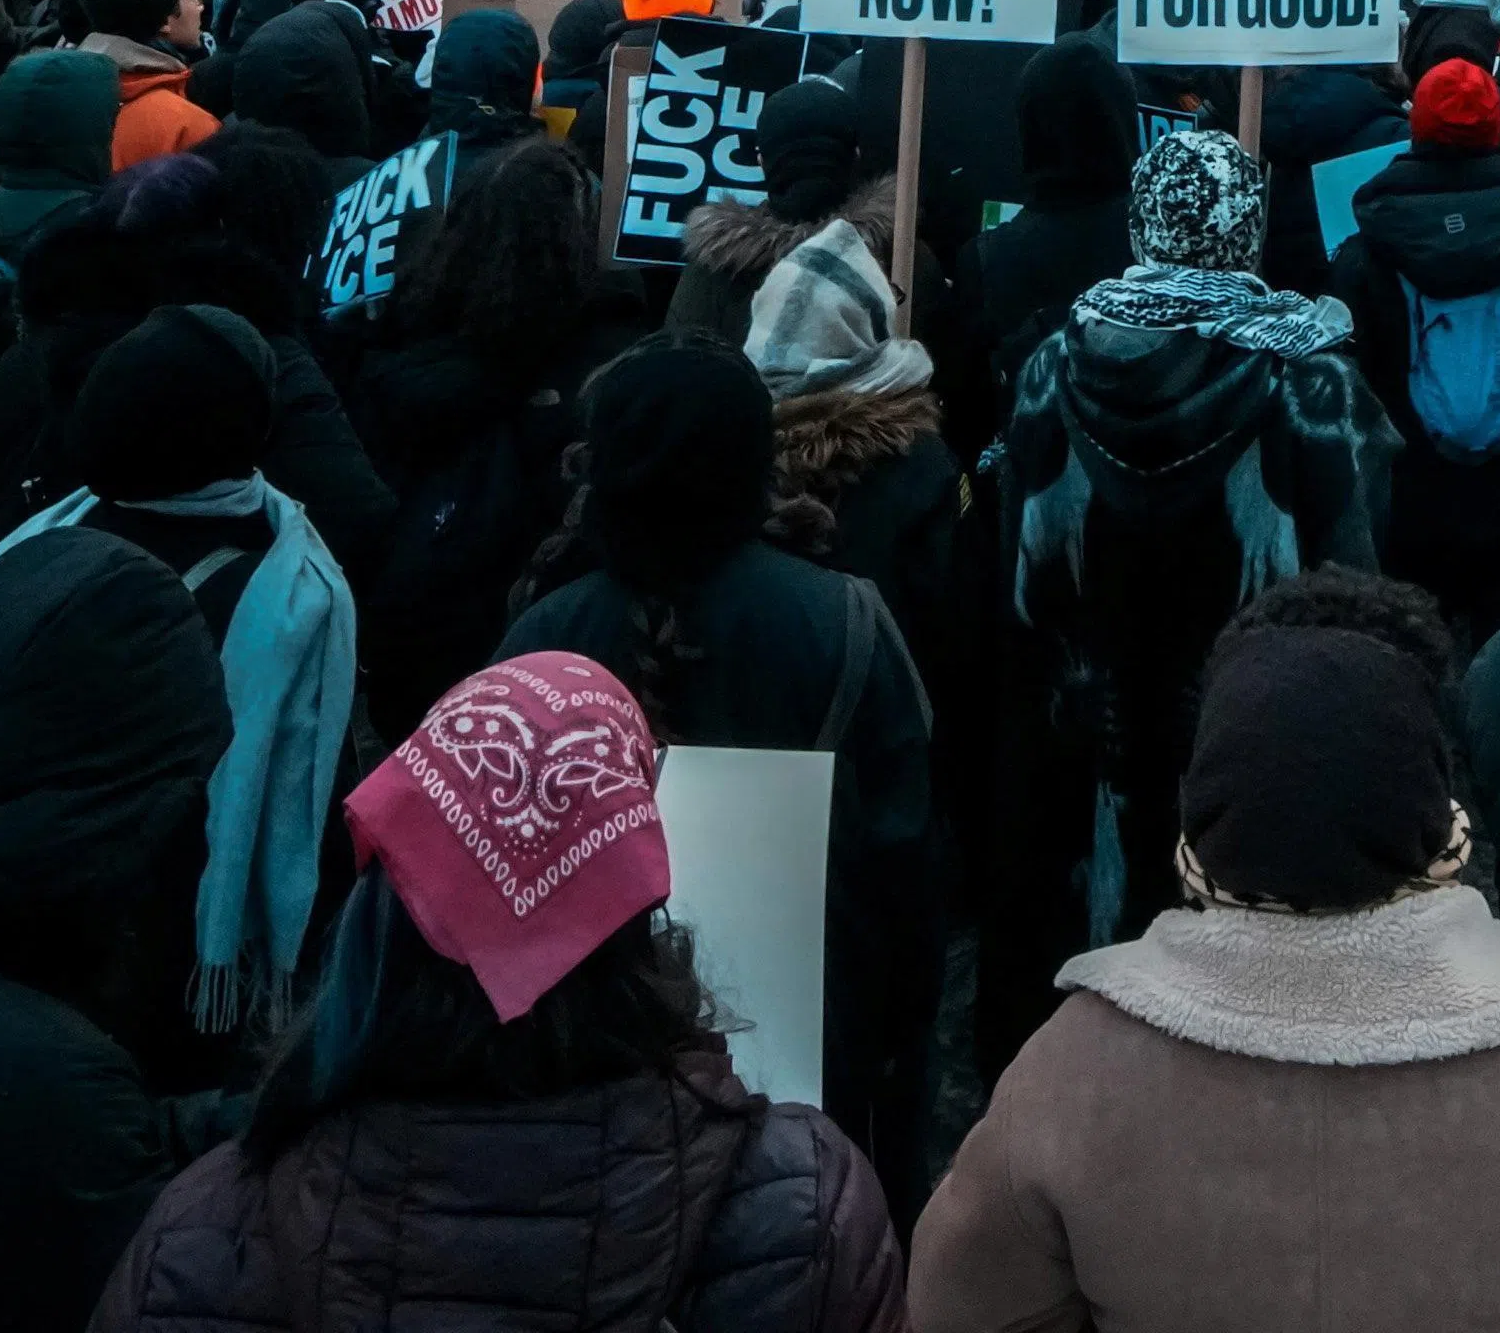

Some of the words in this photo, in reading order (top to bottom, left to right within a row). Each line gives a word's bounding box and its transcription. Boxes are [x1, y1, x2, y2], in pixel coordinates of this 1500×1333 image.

[321, 138, 439, 258] FUCK
[621, 39, 727, 239] FUCK
[706, 85, 769, 207] ICE
[324, 220, 400, 303] ICE
